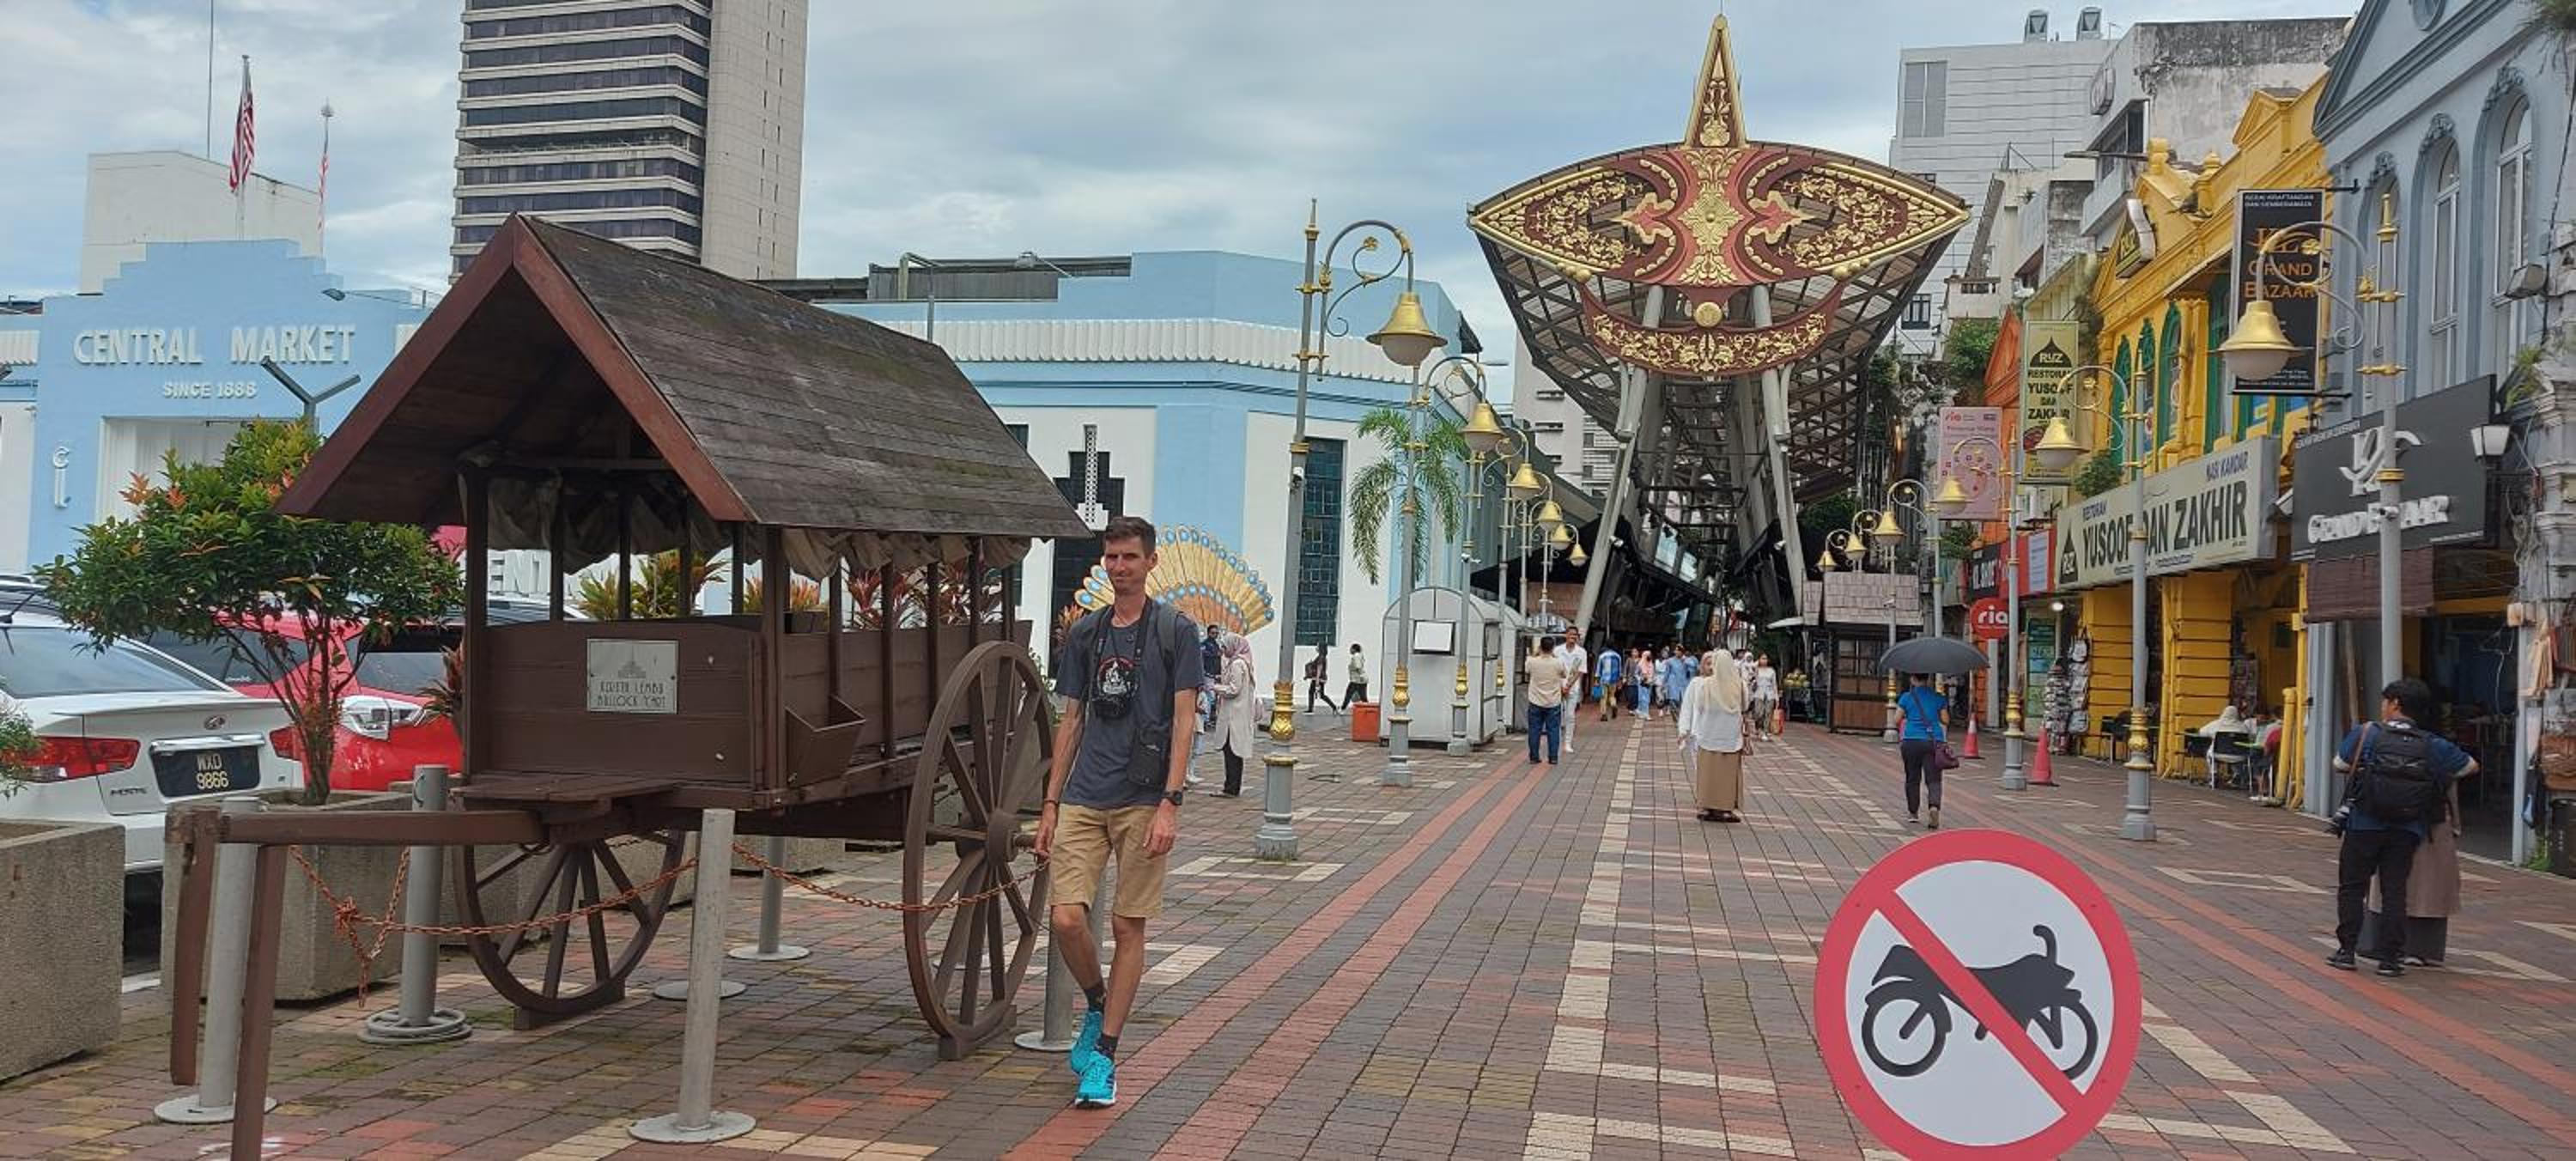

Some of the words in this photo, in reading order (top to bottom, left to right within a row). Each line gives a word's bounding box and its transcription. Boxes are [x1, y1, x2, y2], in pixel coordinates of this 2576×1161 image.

[74, 327, 204, 364] CENTRAL
[230, 325, 356, 364] MARKET
[2039, 352, 2063, 363] RUZ
[162, 381, 211, 398] SINCE
[216, 381, 258, 398] 1888
[2027, 408, 2070, 420] ZAKHR
[2366, 495, 2449, 534] BAAR
[2082, 514, 2133, 570] YUSOOF
[2173, 480, 2247, 550] ZAKHIR
[1978, 604, 2009, 624] ria
[196, 770, 229, 789] 9866
